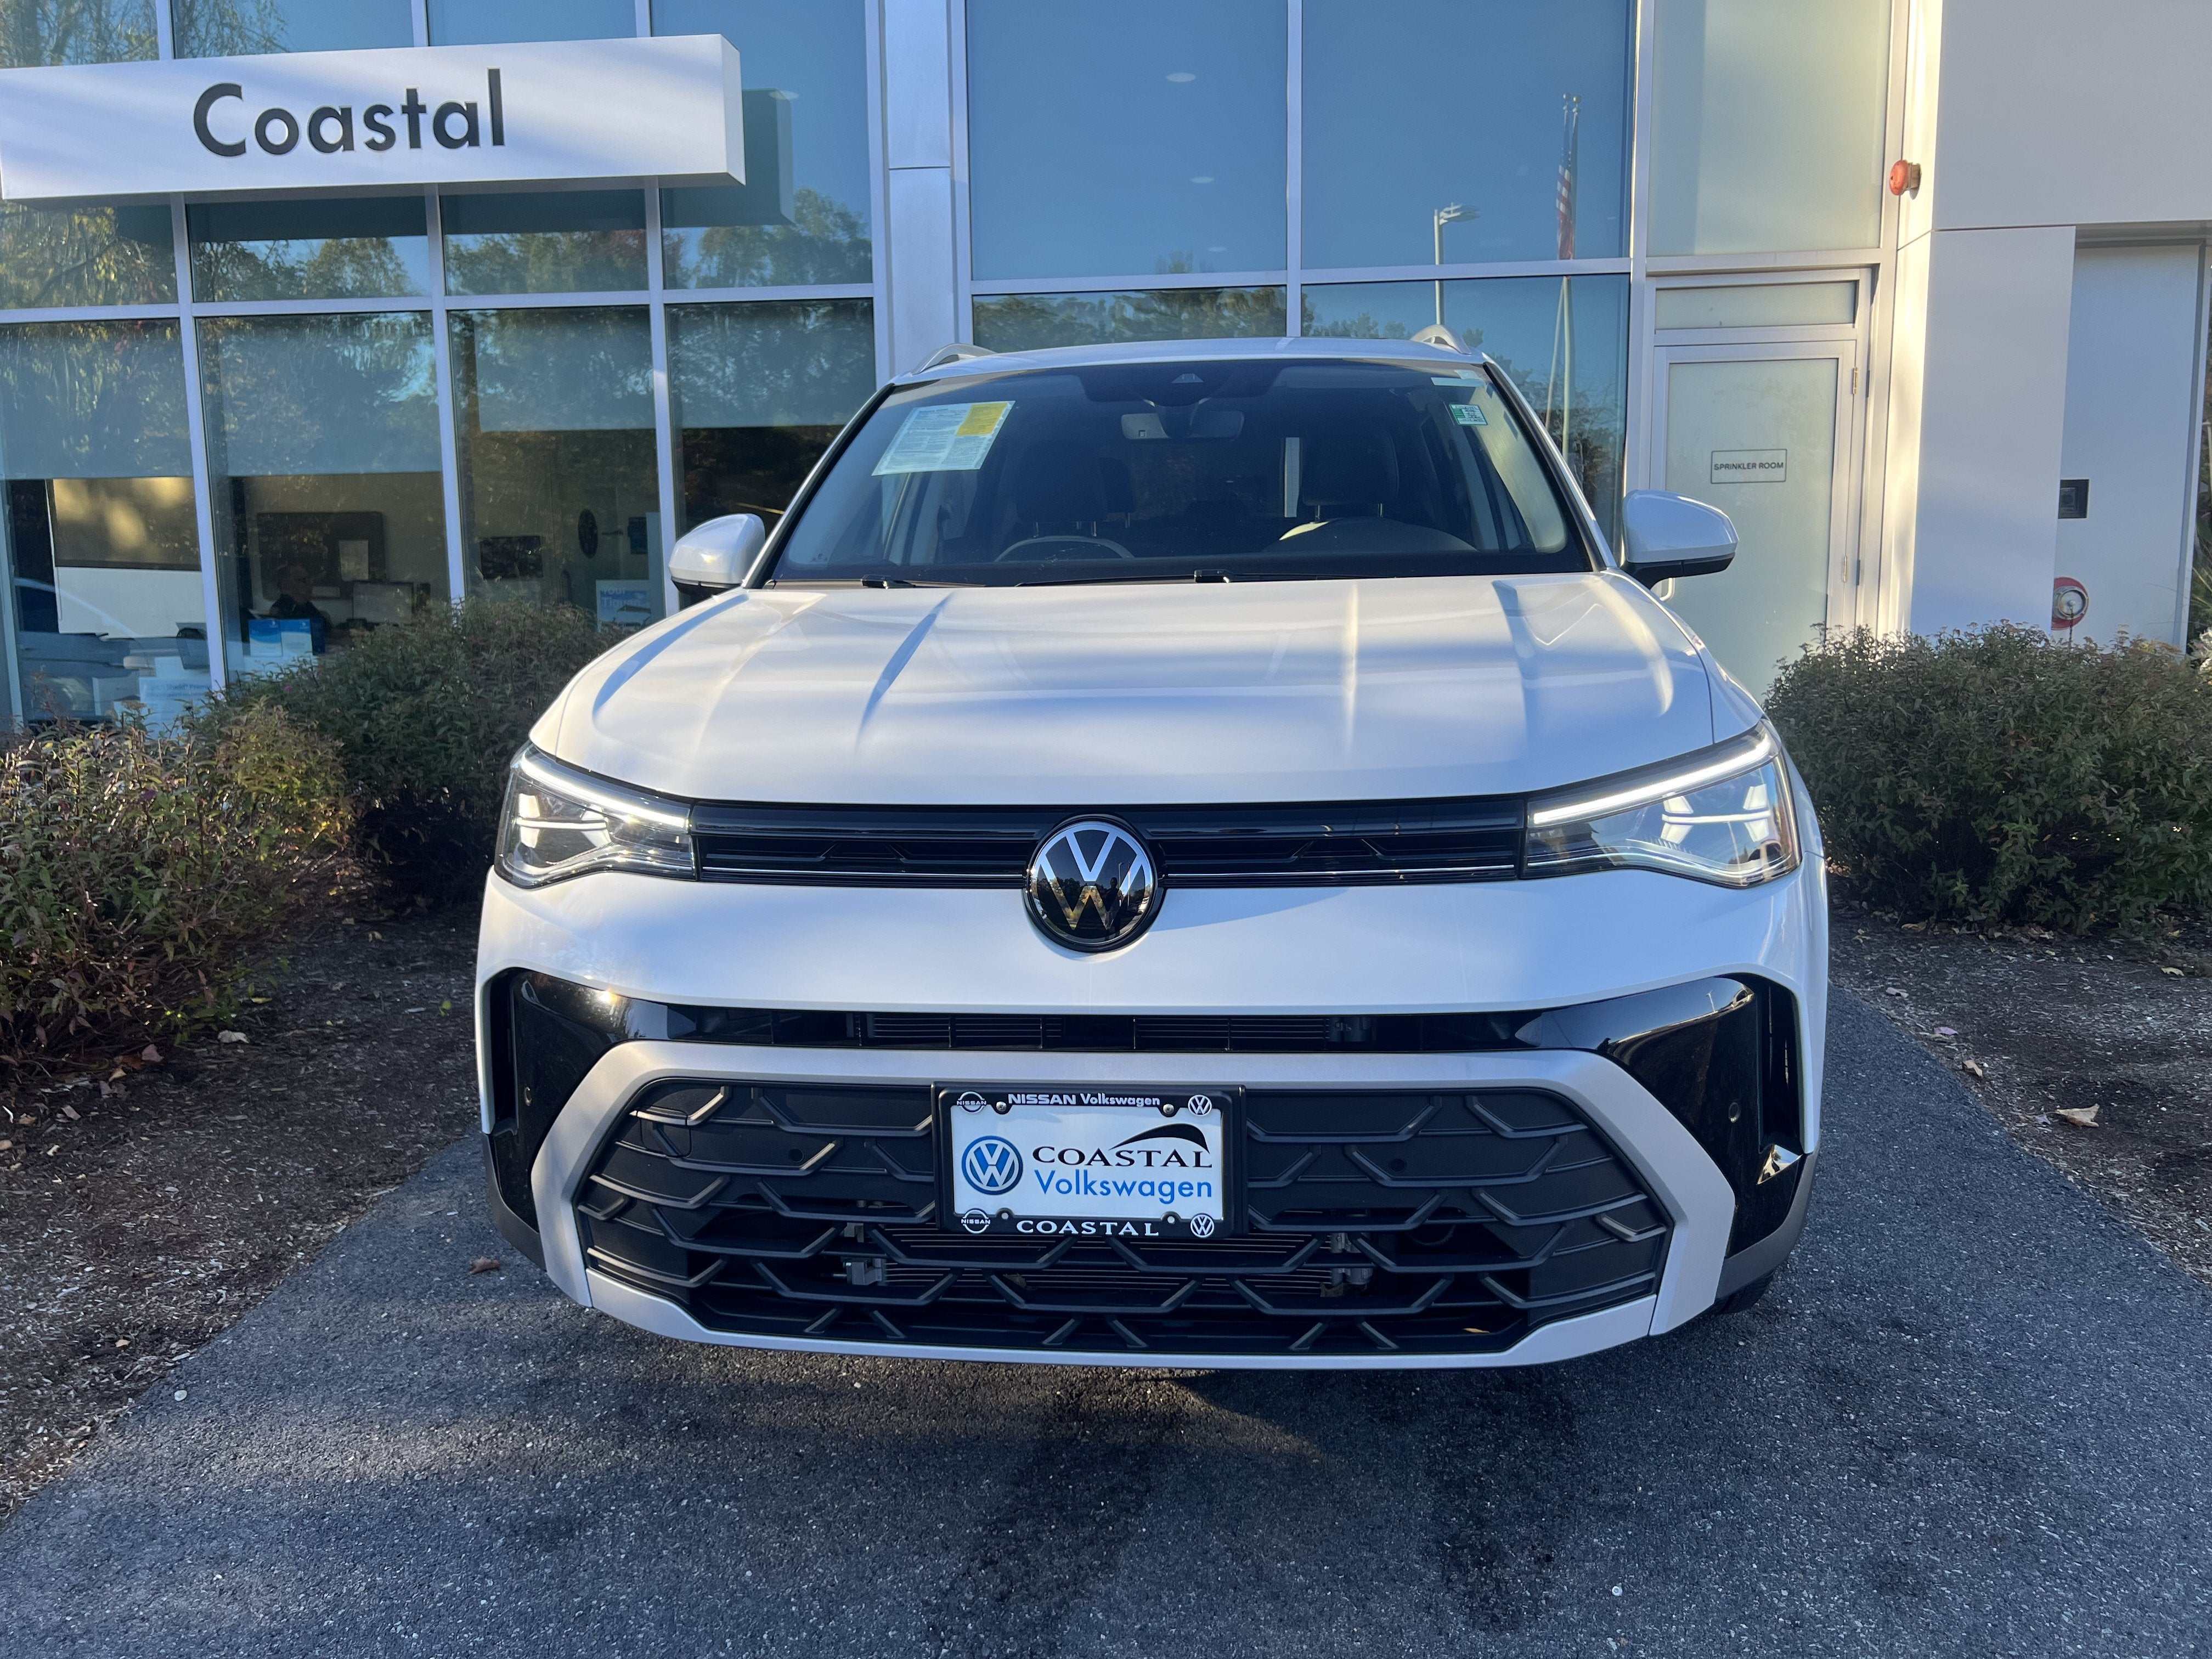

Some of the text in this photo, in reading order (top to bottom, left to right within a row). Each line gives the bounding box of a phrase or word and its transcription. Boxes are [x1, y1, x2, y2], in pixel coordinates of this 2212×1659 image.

[193, 67, 505, 157] Coastal
[1008, 1093, 1160, 1107] NISSAN Volkswagen
[1032, 1146, 1212, 1168] COASTAL
[1035, 1169, 1212, 1204] Volkswagen
[1016, 1220, 1159, 1236] COASTAL
